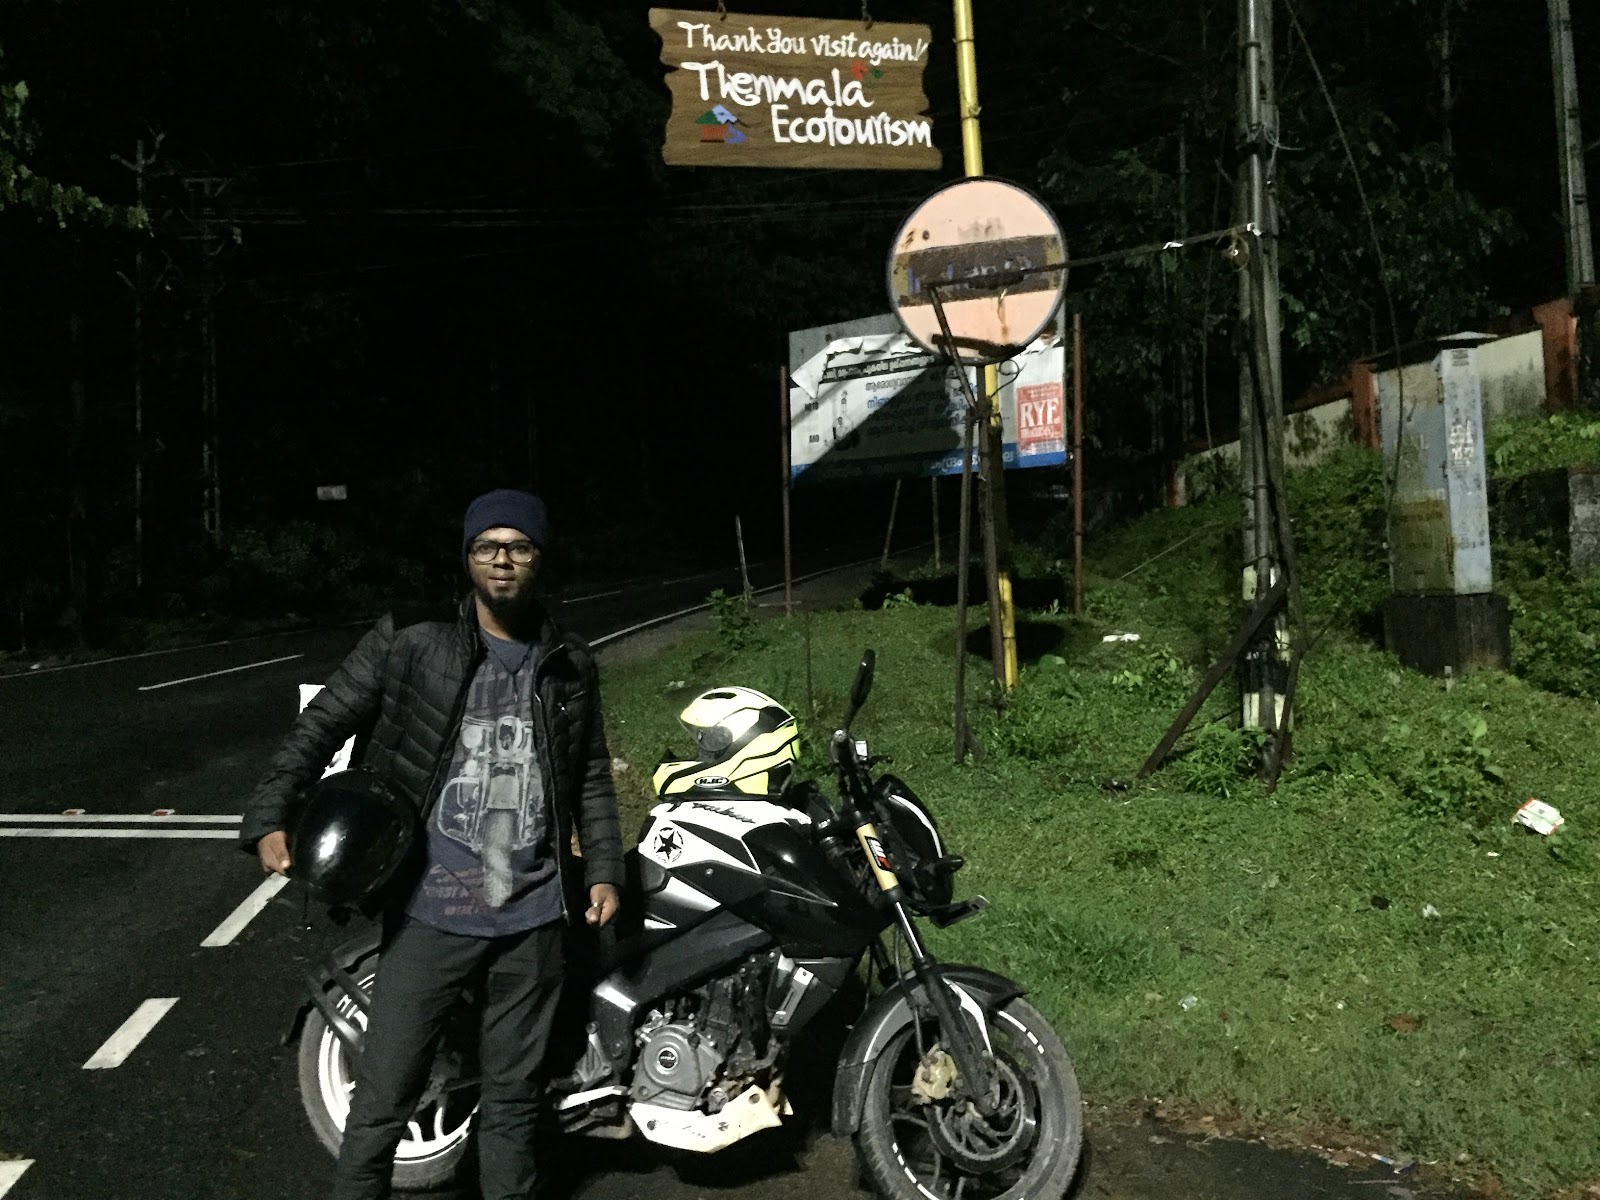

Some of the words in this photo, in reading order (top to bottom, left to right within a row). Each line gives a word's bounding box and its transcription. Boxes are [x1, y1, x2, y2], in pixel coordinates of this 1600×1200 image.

[677, 21, 766, 52] Thank
[810, 32, 858, 58] visit
[680, 60, 874, 107] Thenmala
[771, 104, 932, 148] Ecotourism
